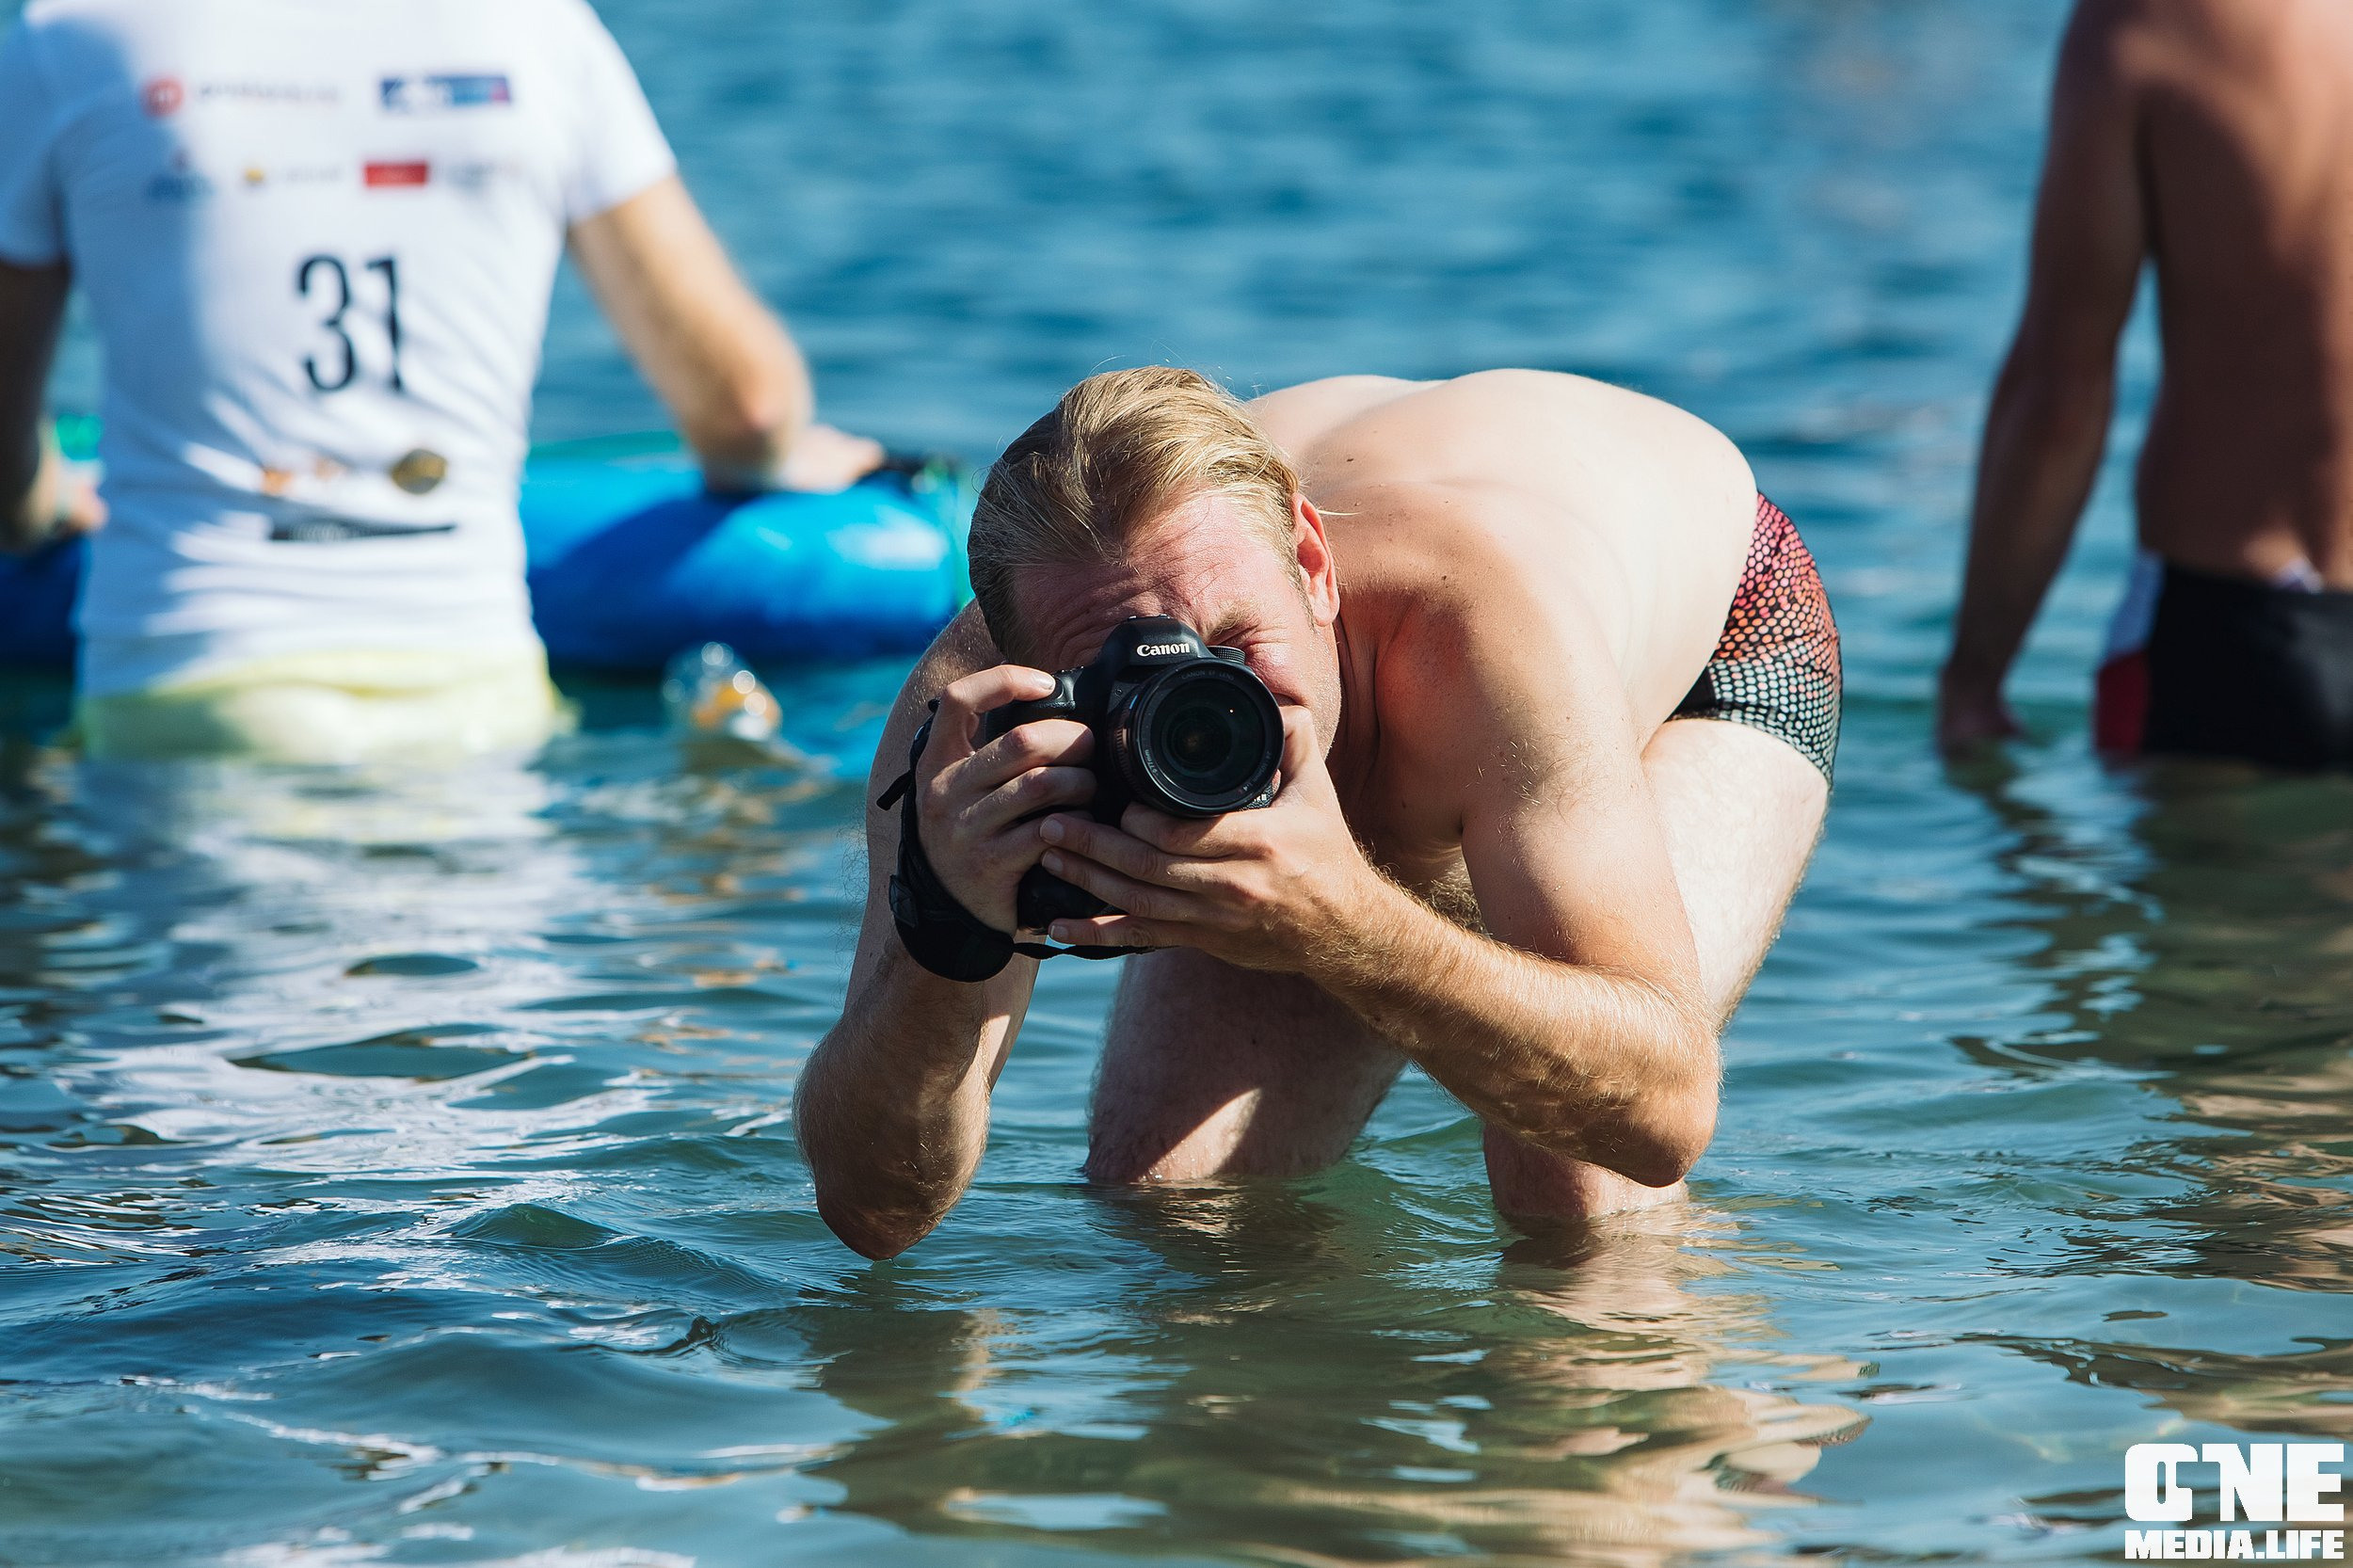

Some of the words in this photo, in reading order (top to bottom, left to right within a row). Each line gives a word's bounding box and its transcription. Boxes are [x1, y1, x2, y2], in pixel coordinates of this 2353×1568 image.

[298, 253, 404, 393] 31
[1137, 643, 1190, 657] Canon
[1181, 669, 1205, 680] CANON
[1220, 670, 1234, 681] LENS
